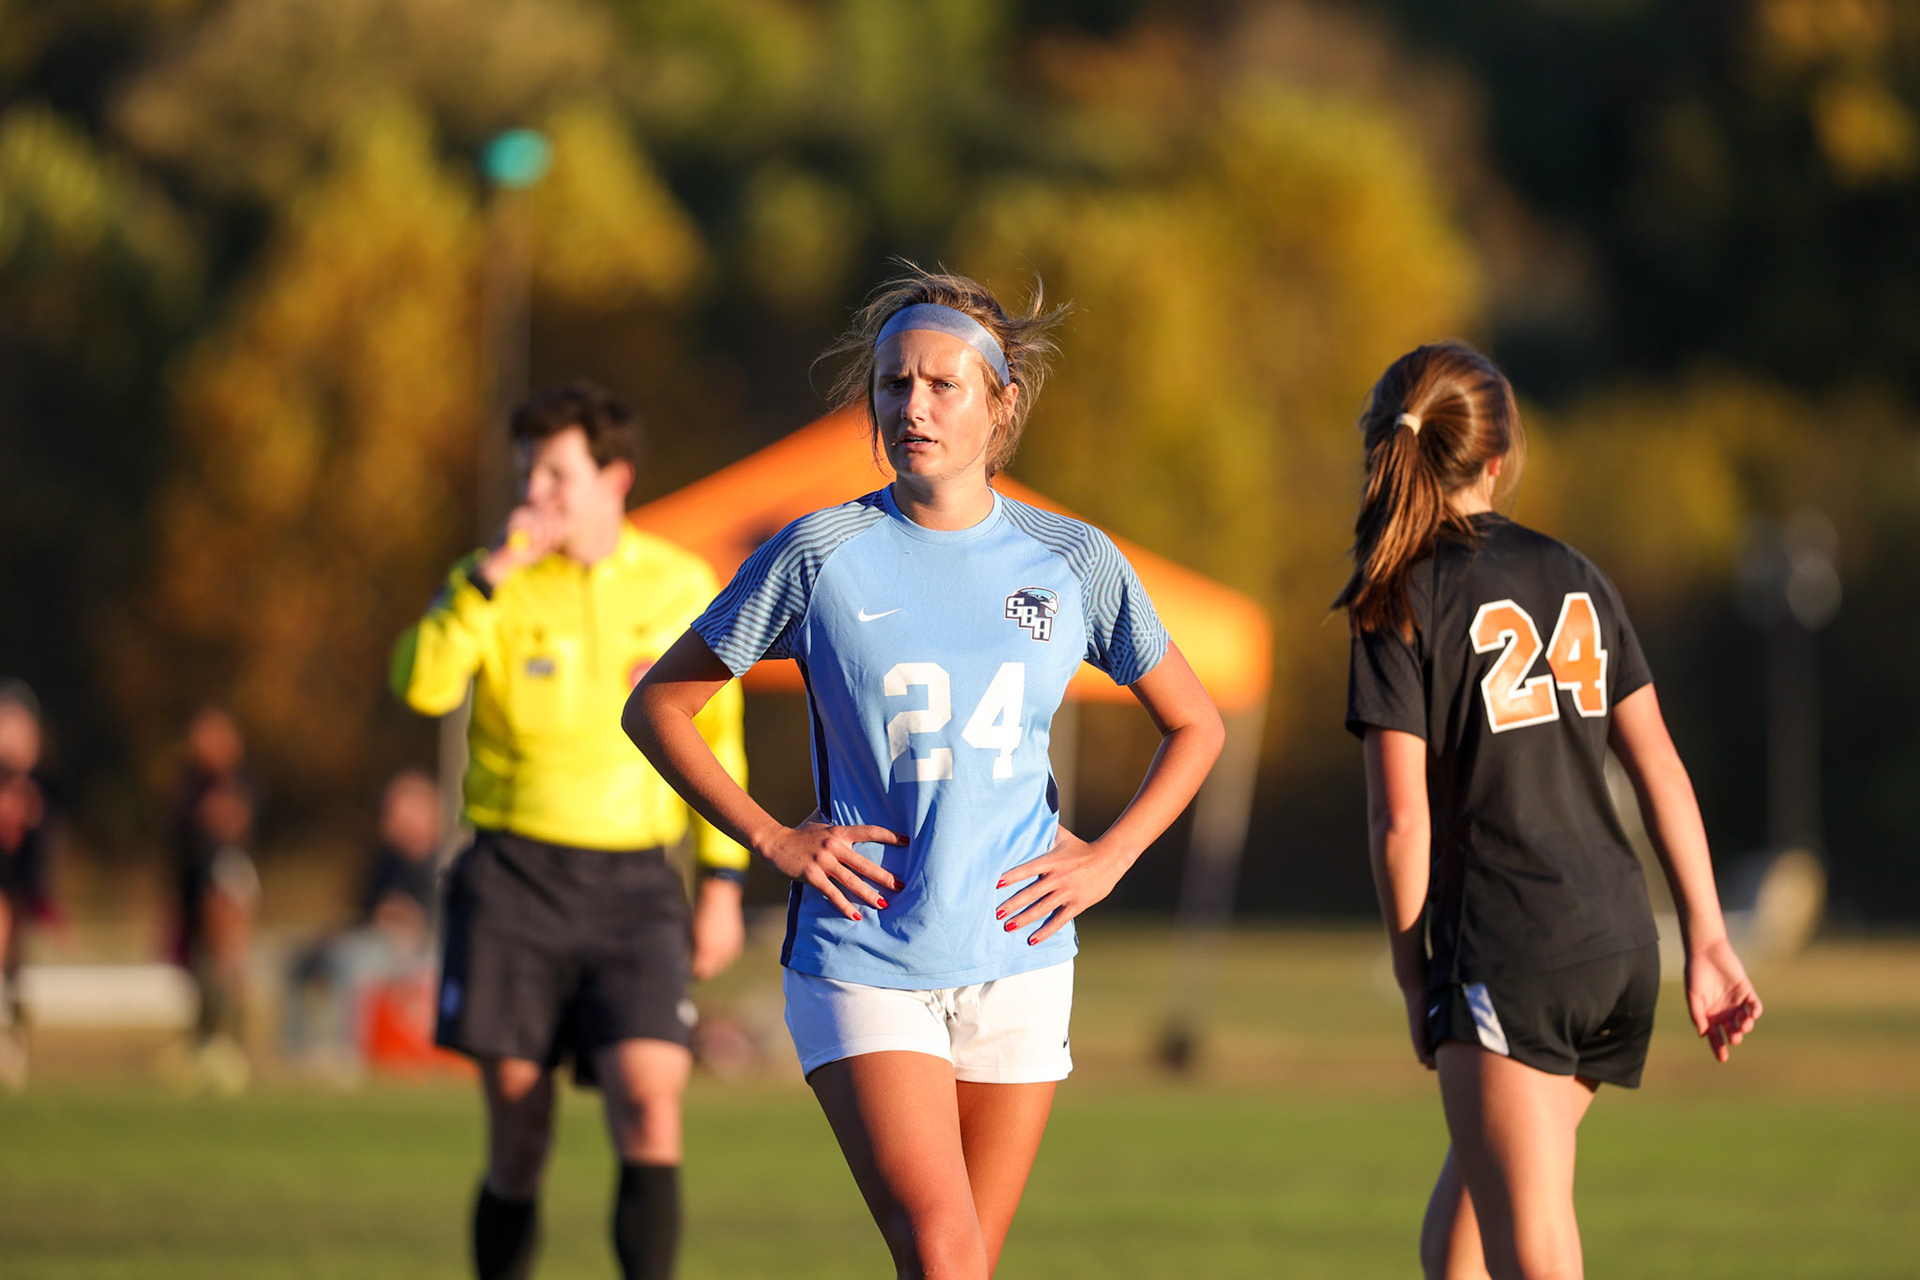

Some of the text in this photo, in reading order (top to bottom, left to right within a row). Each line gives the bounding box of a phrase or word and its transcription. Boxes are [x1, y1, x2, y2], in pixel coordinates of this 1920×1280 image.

[1006, 597, 1051, 640] SBA
[1469, 592, 1608, 734] 24
[883, 662, 1025, 783] 24
